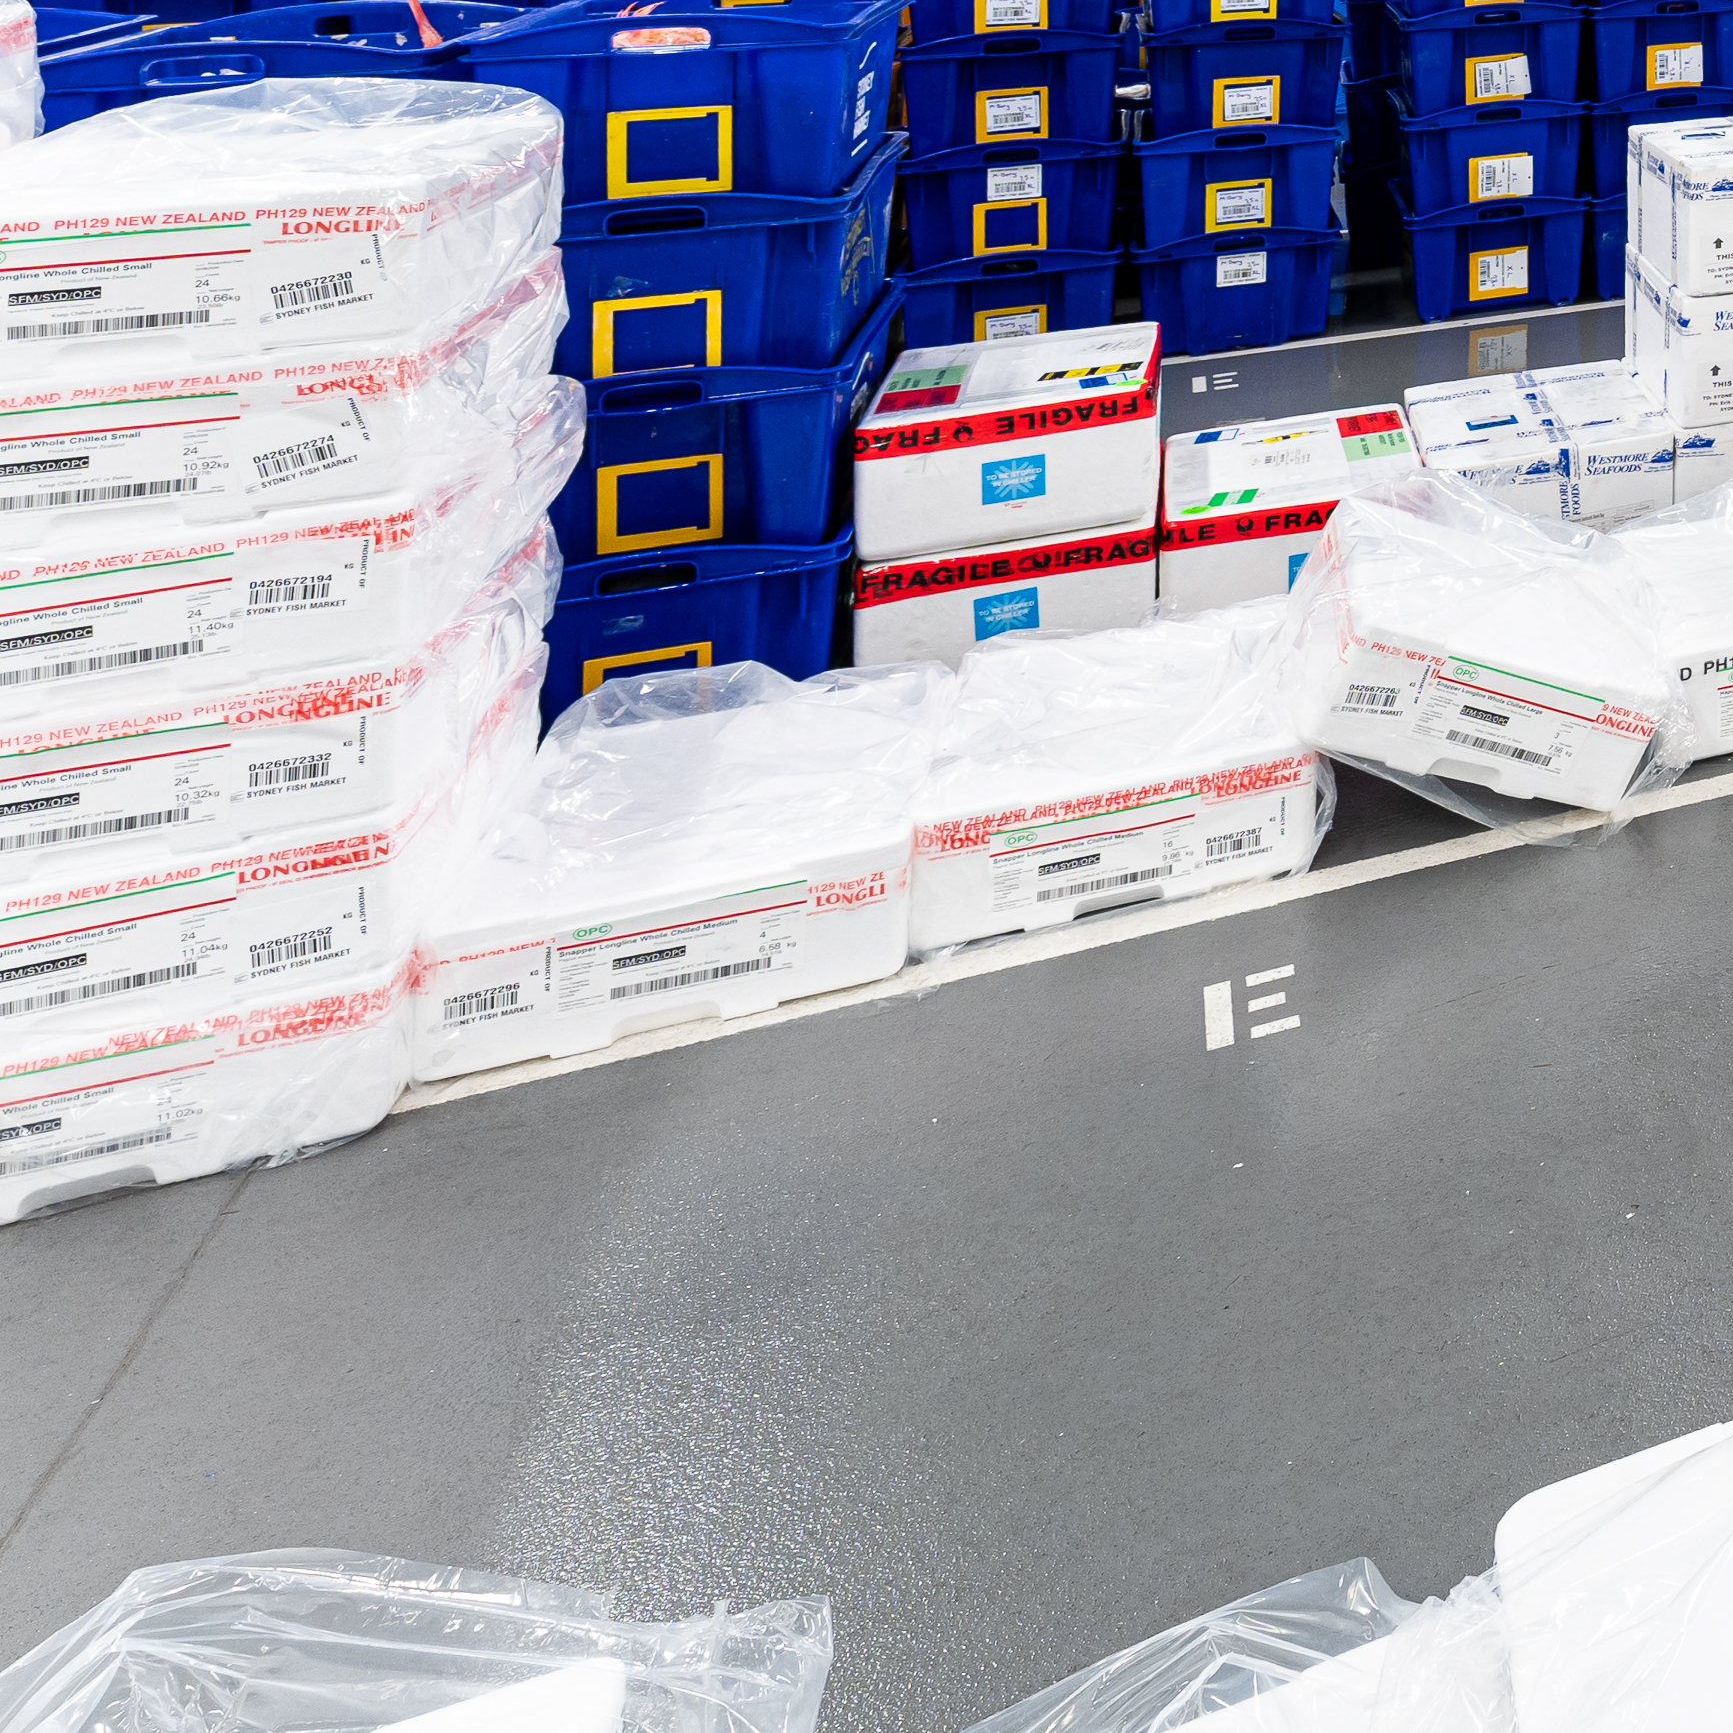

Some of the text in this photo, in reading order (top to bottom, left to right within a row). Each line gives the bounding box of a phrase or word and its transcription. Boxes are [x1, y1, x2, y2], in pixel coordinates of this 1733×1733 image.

[54, 210, 246, 231] PH129 NEW ZEALAND
[256, 208, 307, 219] PH129
[313, 207, 352, 217] NEW
[43, 261, 153, 278] Whole Chilled Small
[195, 279, 210, 288] 24
[270, 271, 353, 294] 0426672230
[8, 287, 102, 306] SFM/SYD/OPC
[275, 293, 374, 320] SYDNEY FISH MARKET
[133, 380, 174, 393] NEW
[180, 371, 263, 386] ZEALAND
[274, 365, 326, 379] PH129
[1712, 380, 1732, 388] THIS
[996, 396, 1139, 435] FRAGILE
[252, 434, 335, 464] 0426672274
[1588, 452, 1649, 466] WESTMORE
[1584, 463, 1642, 477] SEAFOODS
[141, 532, 289, 563] ZEALAND PH129
[249, 574, 333, 589] 0426672194
[246, 599, 346, 616] SYDNEY FISH MARKET
[49, 701, 247, 740] NEW ZEALAND PH129
[248, 753, 332, 771] 0426672332
[7, 856, 263, 911] PH129 NEW ZEALAND PH129
[249, 926, 333, 953] 0426672252
[559, 918, 738, 959] Snapper Longline Whole Chilled Medium
[576, 925, 610, 938] OPC
